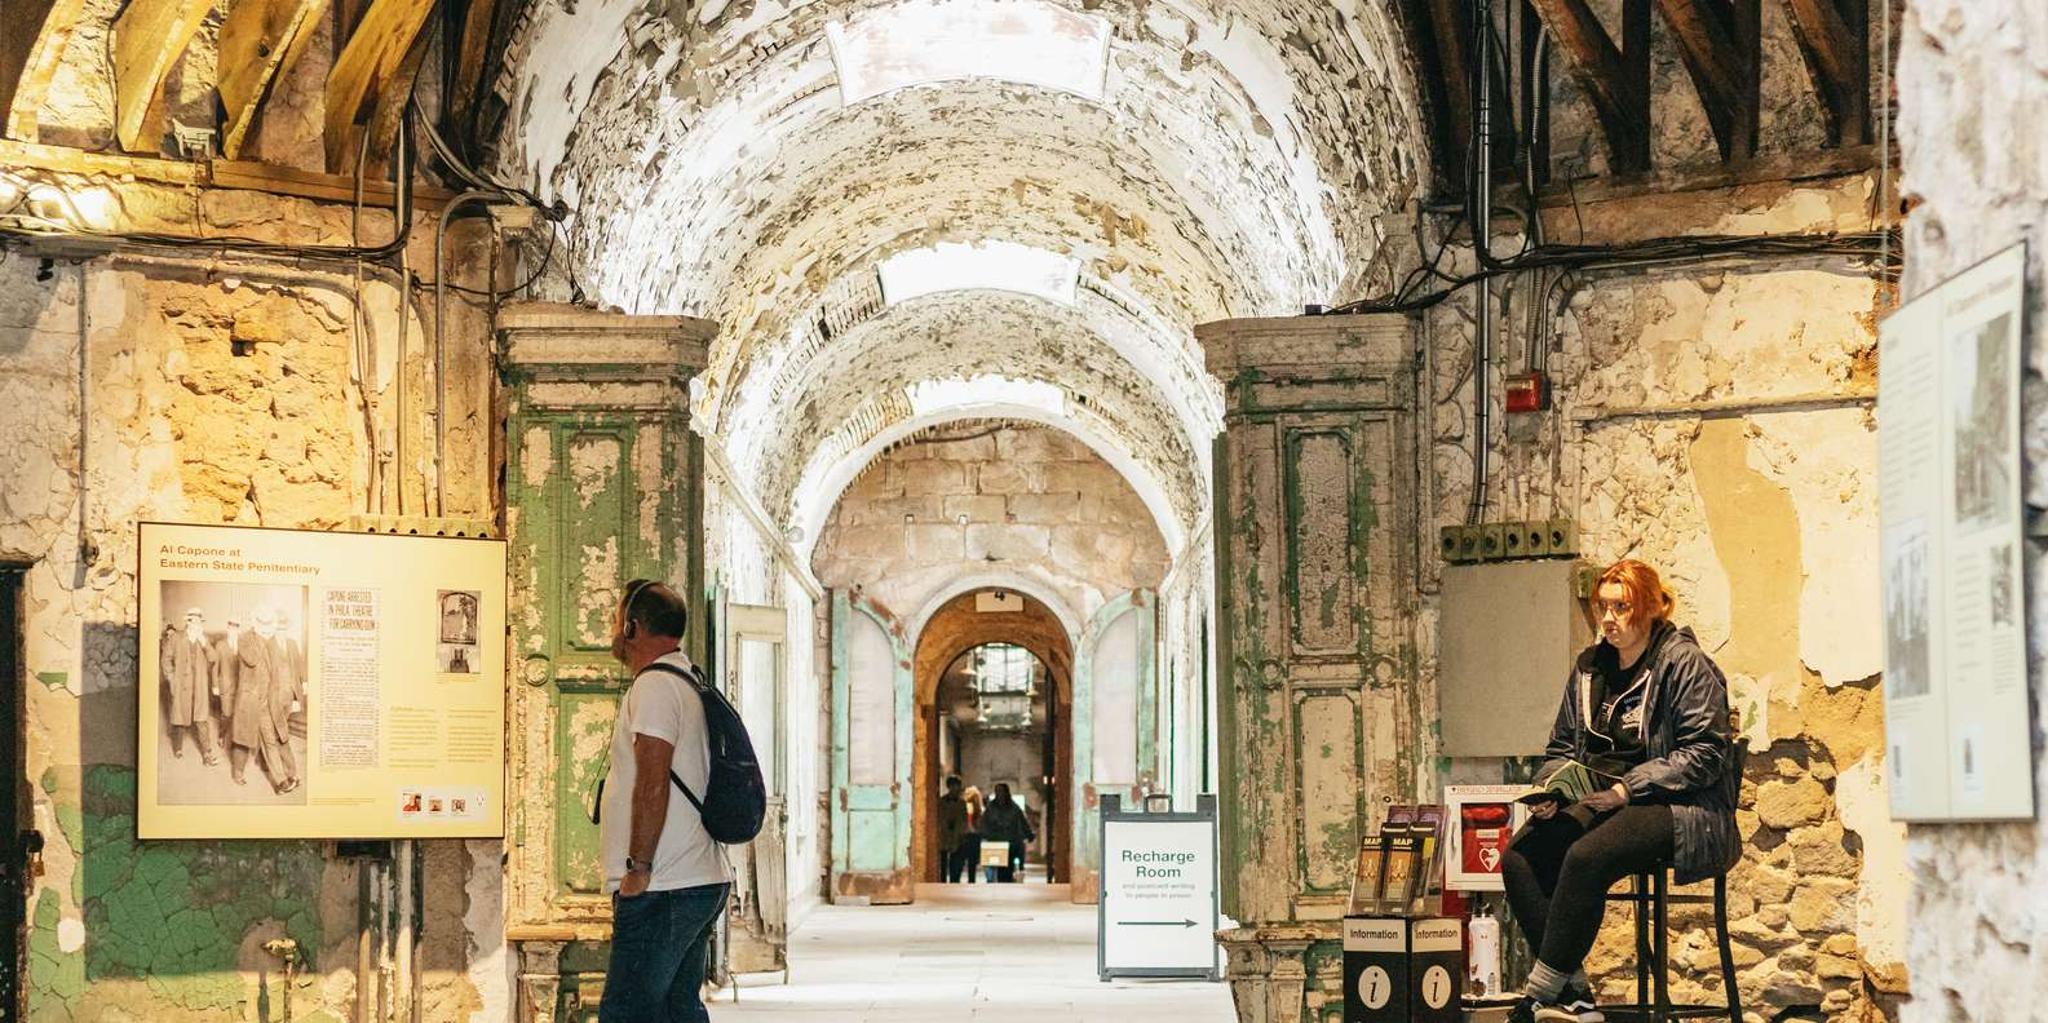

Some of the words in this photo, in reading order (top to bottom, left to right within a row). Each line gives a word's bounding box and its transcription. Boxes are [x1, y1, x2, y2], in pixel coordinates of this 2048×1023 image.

[160, 545, 173, 554] Al
[177, 545, 225, 557] Capone
[230, 548, 241, 557] at
[160, 559, 209, 569] Eastern
[213, 560, 245, 571] State
[248, 562, 321, 575] Penitentiary
[1393, 838, 1413, 846] MAP
[1122, 850, 1195, 865] Recharge
[1136, 866, 1181, 878] Room
[1350, 928, 1399, 939] Information
[1415, 928, 1458, 940] Information
